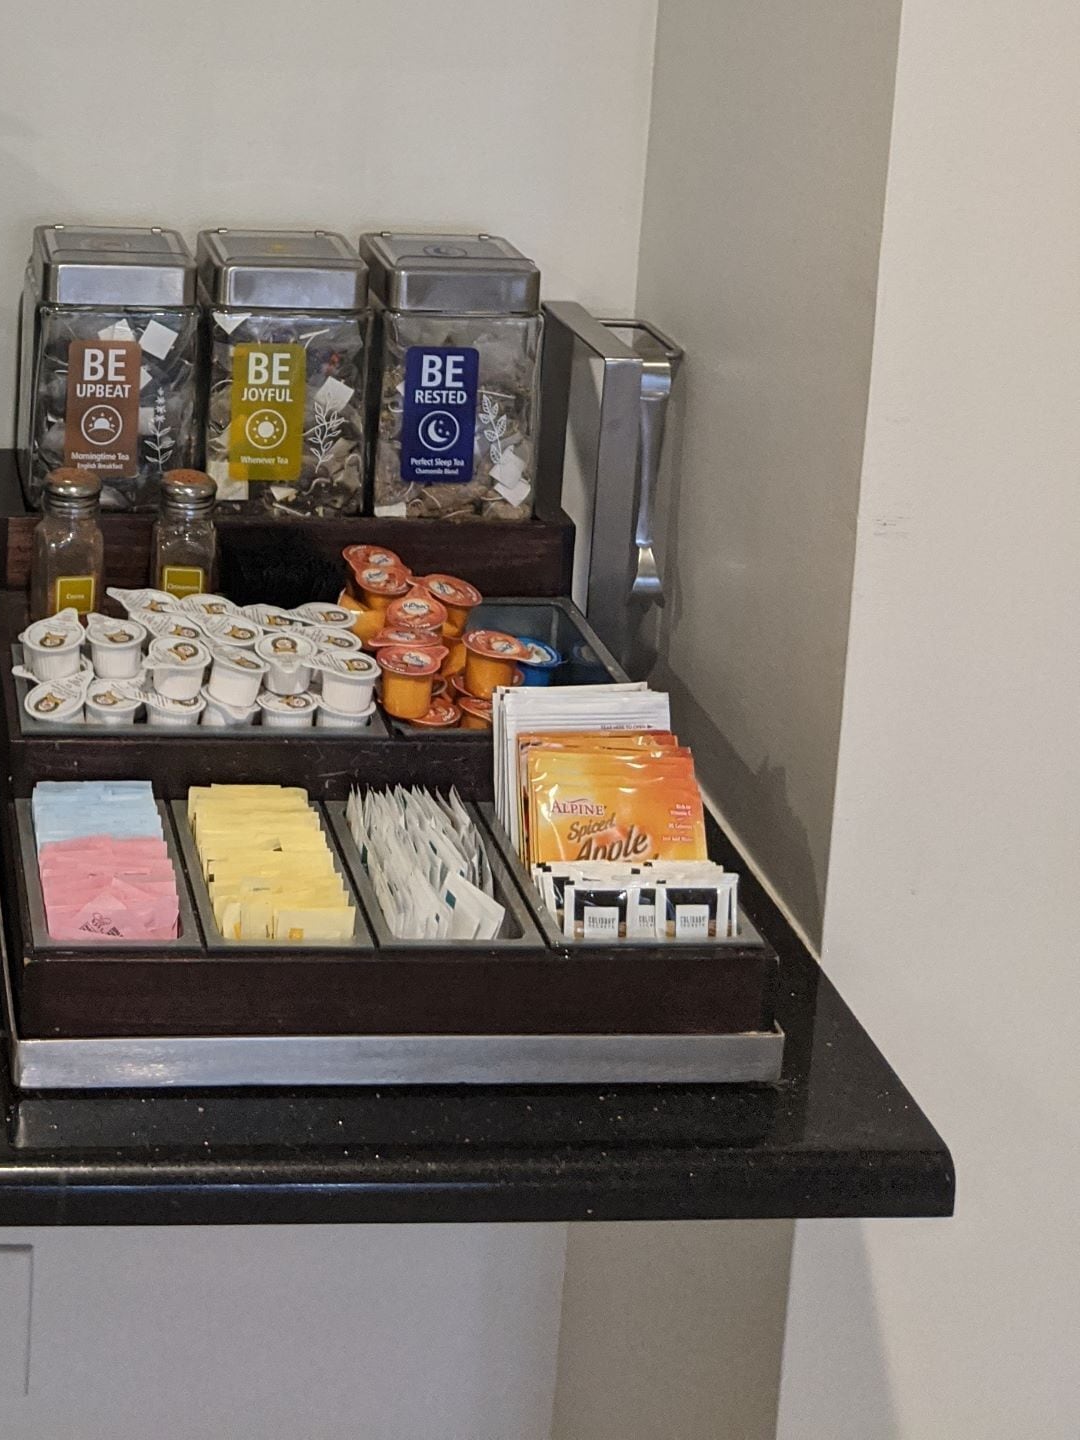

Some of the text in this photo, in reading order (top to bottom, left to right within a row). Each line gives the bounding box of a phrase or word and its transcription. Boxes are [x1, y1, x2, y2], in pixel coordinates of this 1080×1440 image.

[83, 348, 127, 382] BE
[248, 351, 291, 386] BE
[421, 354, 465, 388] BE
[76, 383, 131, 399] UPBEAT
[241, 387, 294, 402] JOYFUL
[414, 389, 467, 404] RESTED
[117, 452, 130, 461] Tea
[277, 456, 289, 465] Tea
[434, 457, 453, 467] Sleep
[453, 458, 465, 466] Tea
[551, 800, 604, 816] ALPINE
[567, 811, 617, 843] Spiced
